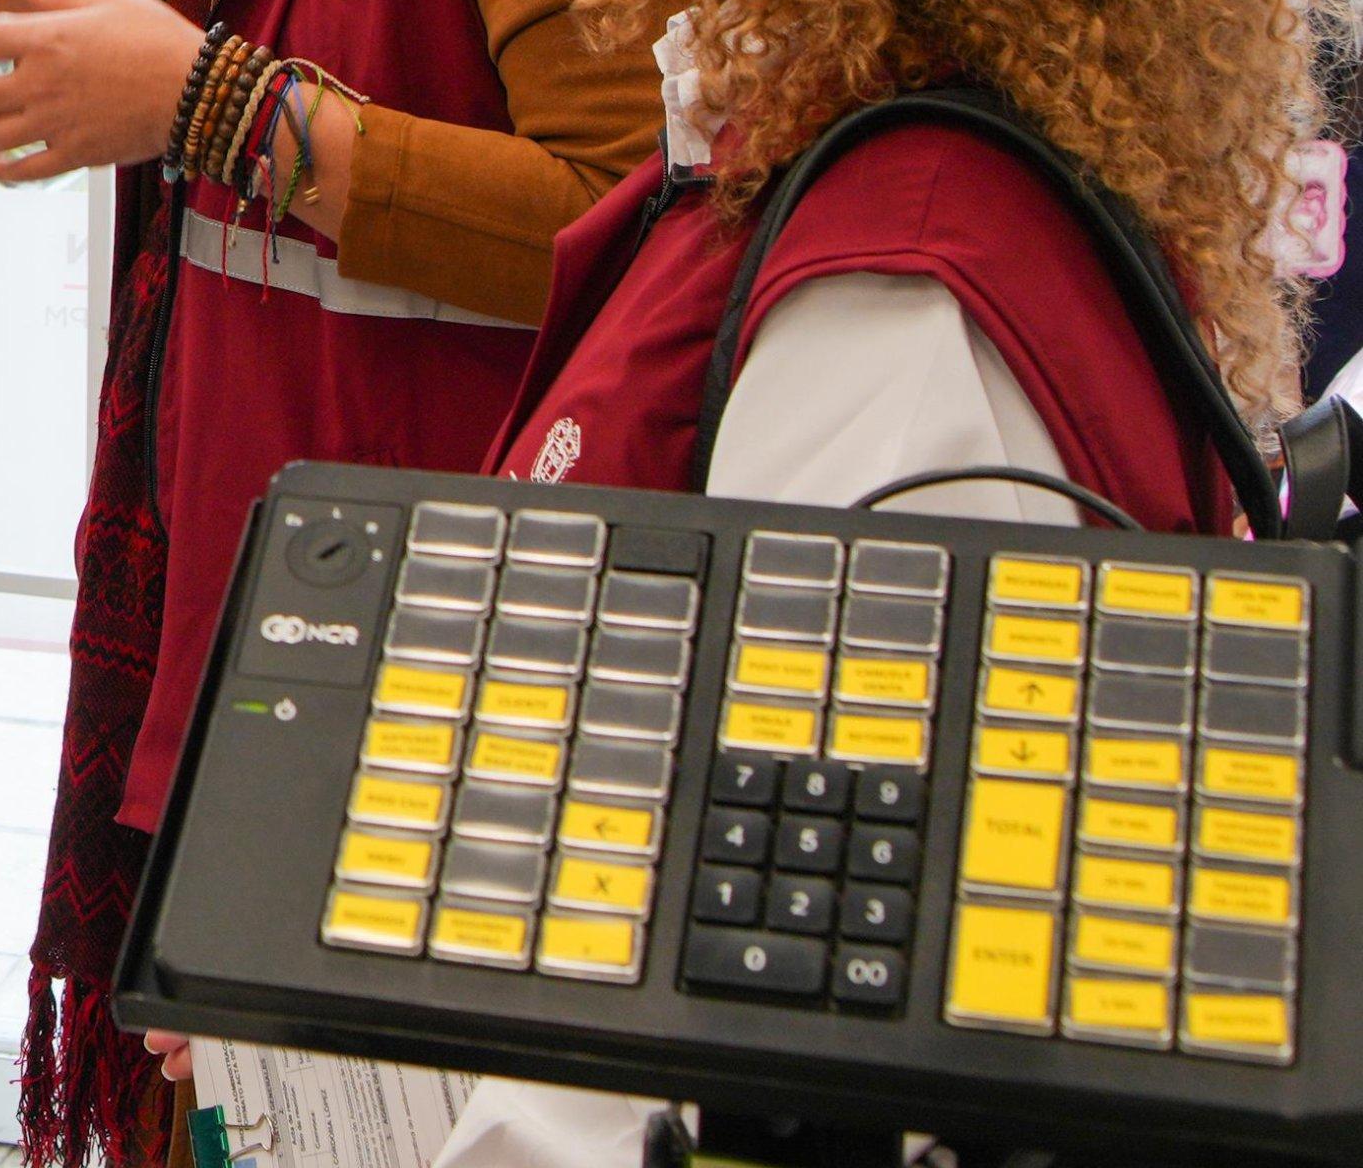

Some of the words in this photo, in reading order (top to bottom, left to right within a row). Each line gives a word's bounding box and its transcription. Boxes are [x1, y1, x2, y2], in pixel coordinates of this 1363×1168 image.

[736, 764, 754, 789] 7
[806, 772, 826, 797] 8
[879, 781, 899, 805] 9
[726, 824, 745, 848] 4
[798, 828, 819, 853] 5
[872, 839, 893, 864] 6
[717, 881, 733, 906] 1
[789, 891, 810, 917] 2
[865, 898, 886, 925] 3
[743, 944, 767, 972] 0
[846, 957, 889, 988] 00
